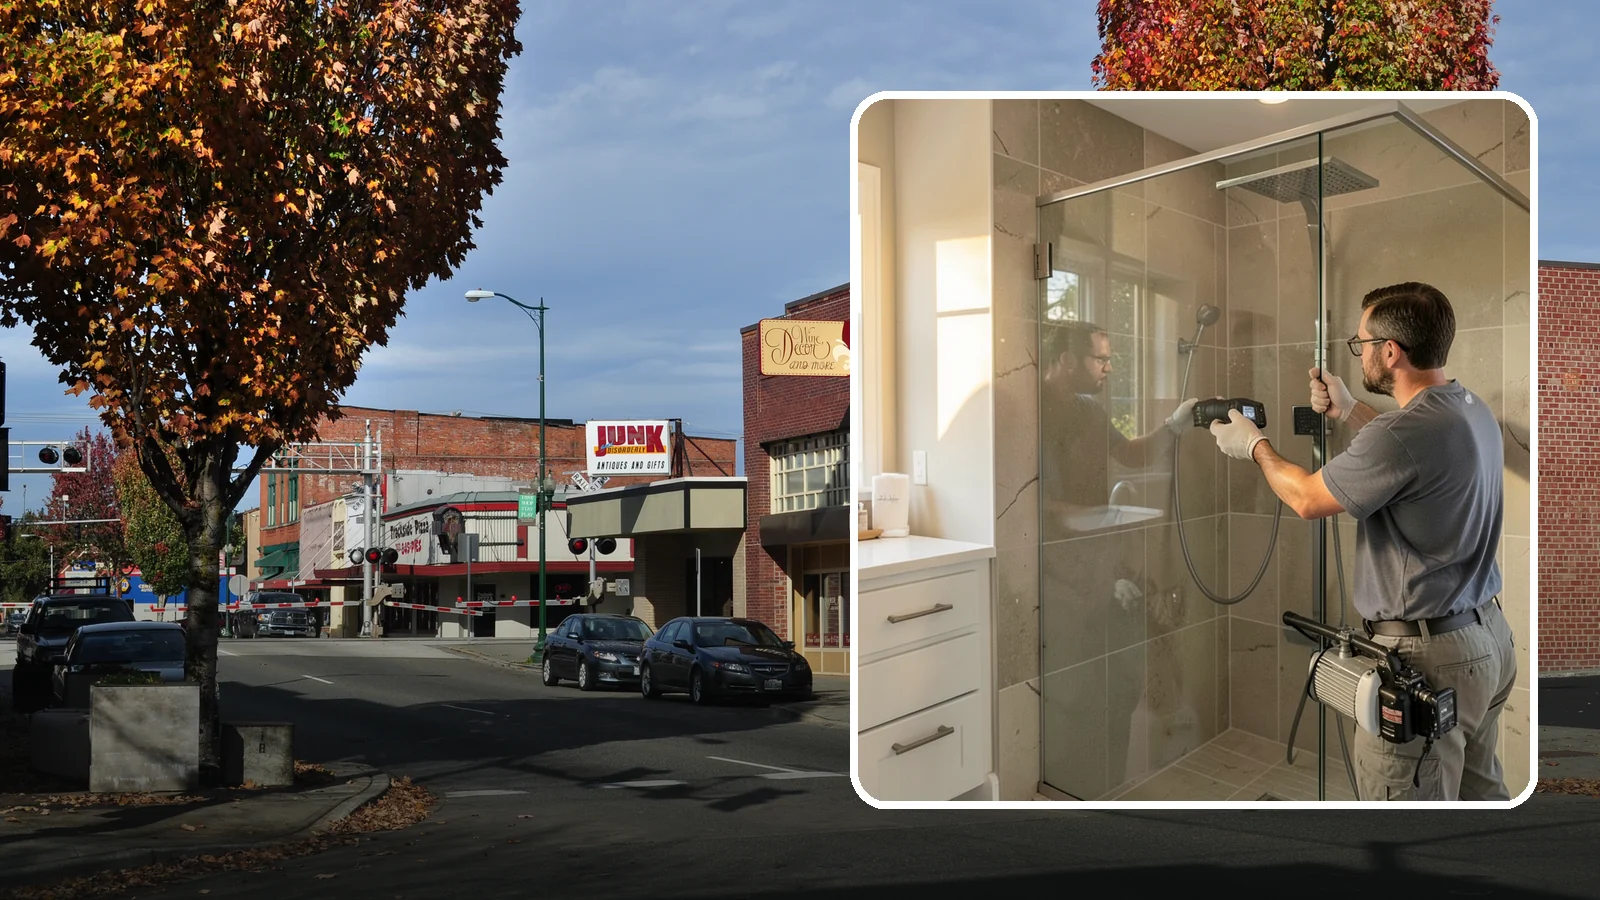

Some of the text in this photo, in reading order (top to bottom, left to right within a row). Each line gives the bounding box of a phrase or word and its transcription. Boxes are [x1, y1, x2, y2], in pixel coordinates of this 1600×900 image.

[765, 328, 831, 365] Decor
[595, 425, 666, 457] JUNK
[607, 446, 646, 454] DISORDERLY
[597, 460, 665, 470] ANTIQUES AND GIFTS
[573, 473, 590, 492] RAIL
[415, 519, 429, 535] Pizza
